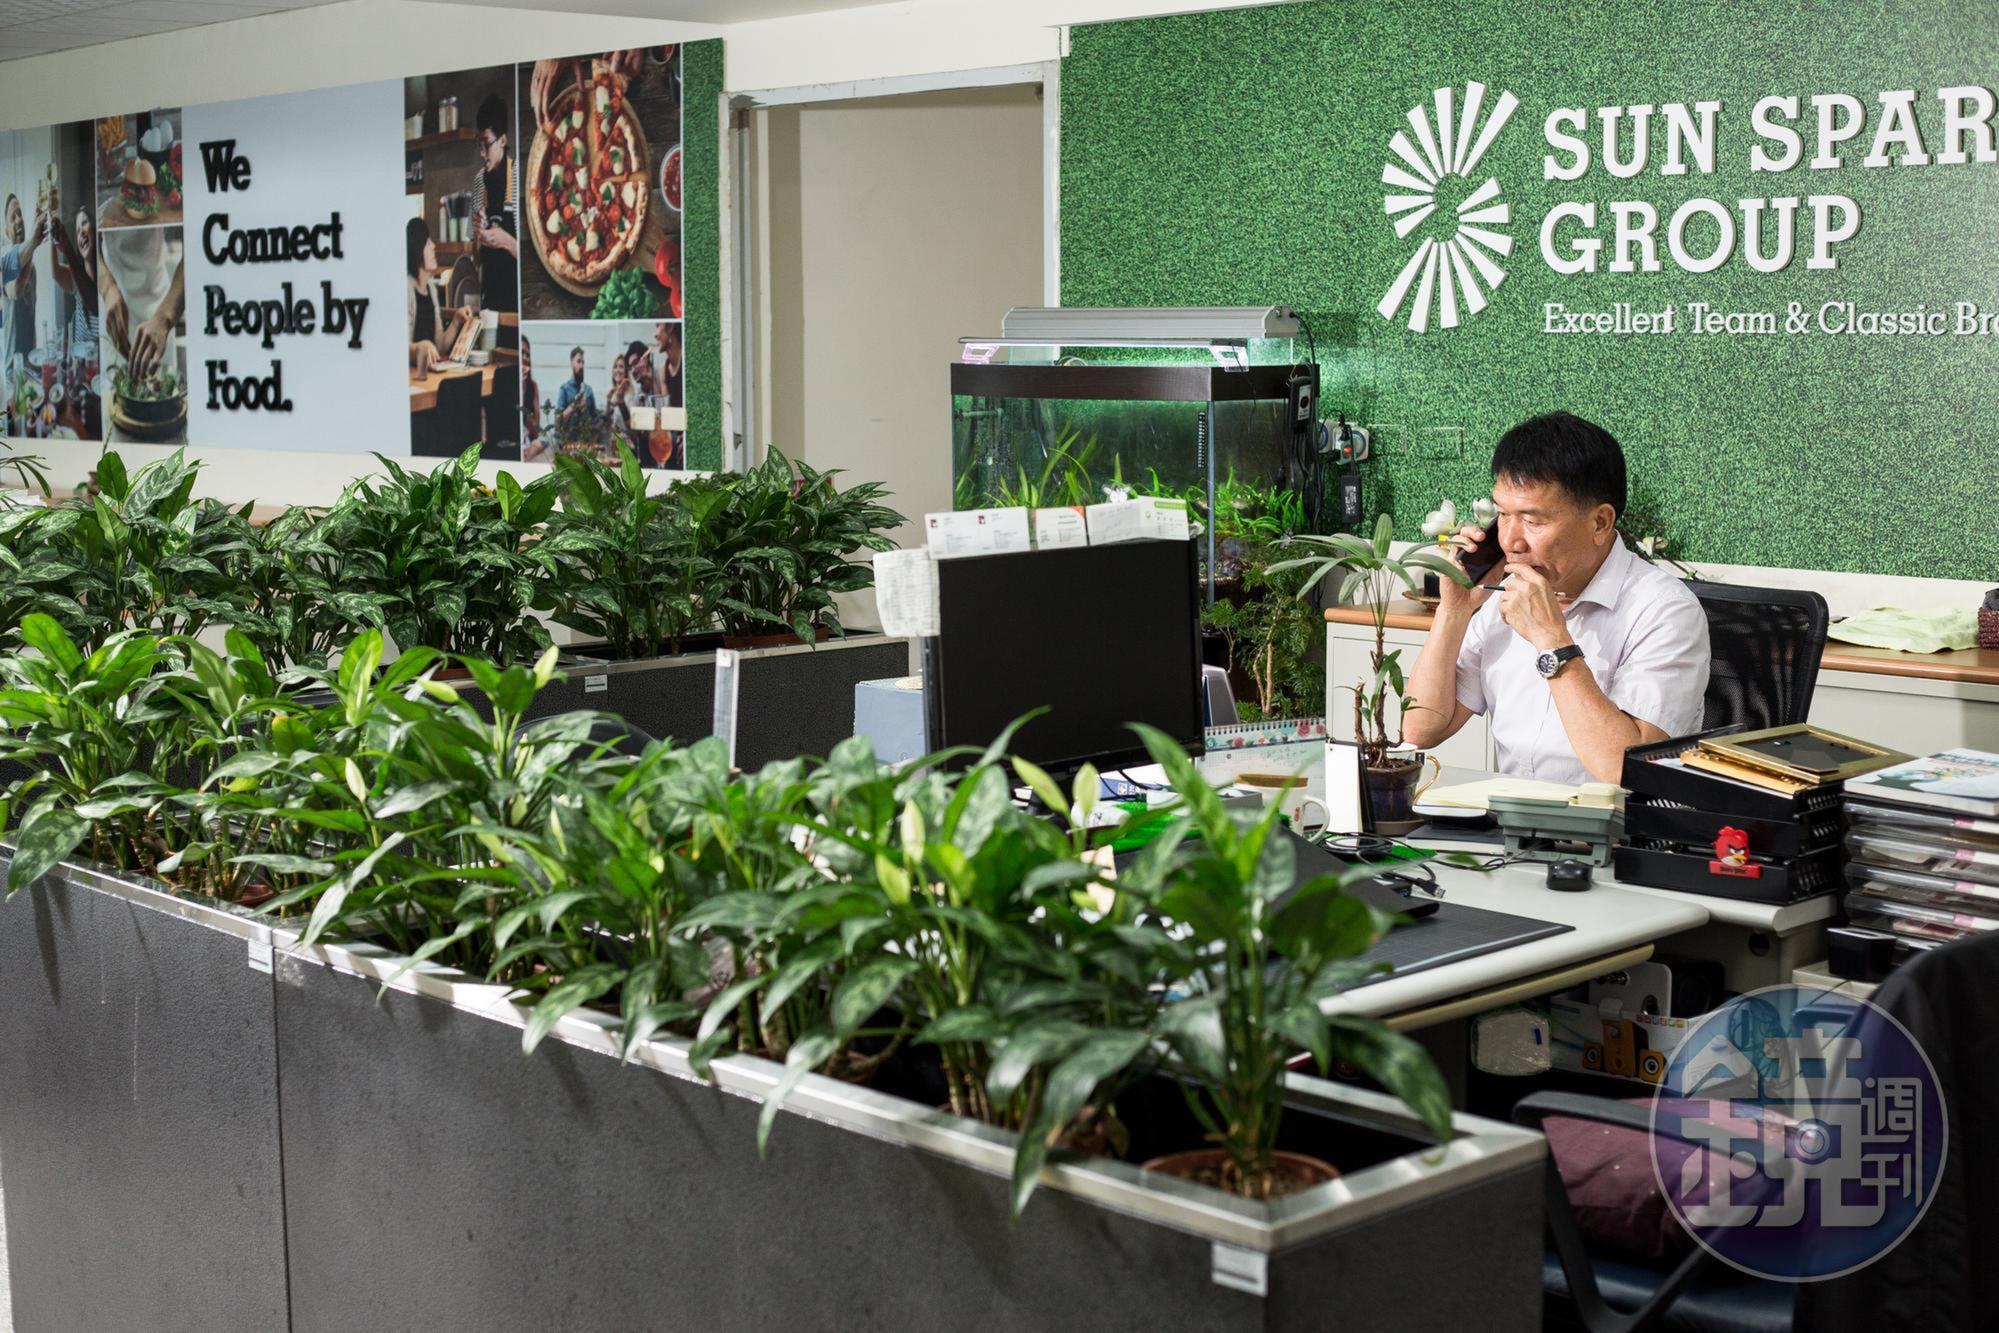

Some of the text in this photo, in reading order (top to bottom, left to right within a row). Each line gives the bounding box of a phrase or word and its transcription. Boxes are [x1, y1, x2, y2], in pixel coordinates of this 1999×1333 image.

[1543, 85, 1998, 182] SUN SPAR
[199, 139, 252, 193] We
[203, 211, 344, 266] Connect
[1539, 195, 1863, 275] GROUP
[203, 280, 369, 349] People by
[1543, 302, 1675, 334] Excellent
[1687, 302, 1778, 334] Team
[1785, 301, 1810, 334] &
[1818, 301, 1948, 335] Classic
[205, 359, 293, 413] Food.
